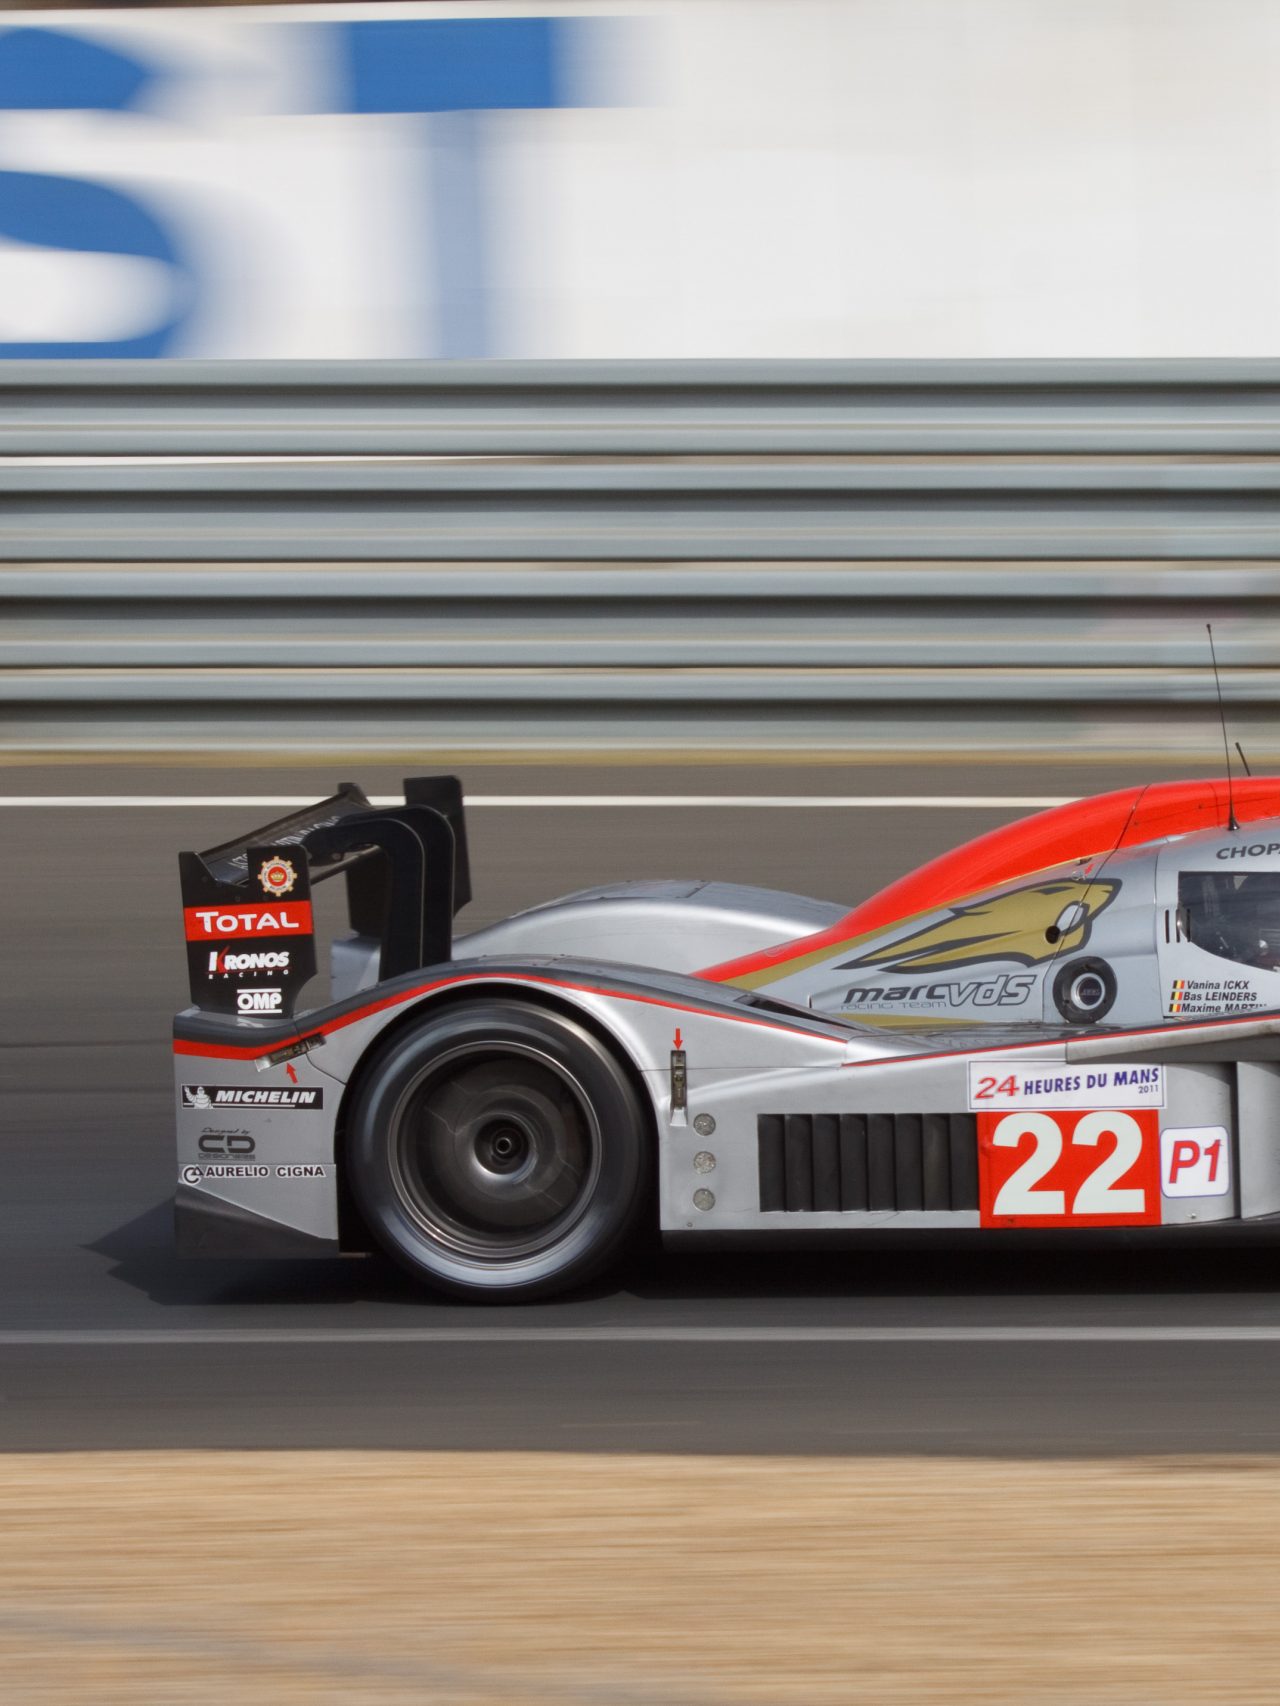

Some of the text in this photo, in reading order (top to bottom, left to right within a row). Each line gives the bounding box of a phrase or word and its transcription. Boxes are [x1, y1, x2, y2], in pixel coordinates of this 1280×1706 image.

[195, 911, 300, 933] TOTAL
[208, 947, 290, 973] KRONOS
[208, 969, 290, 980] RACING
[1187, 980, 1250, 990] Vanina ICKX
[236, 991, 283, 1011] OMP
[1183, 991, 1257, 1002] Bas LEINDERS
[1181, 1003, 1221, 1013] Maxime
[973, 1067, 1159, 1100] 24 HEURES DU MANS
[1138, 1084, 1159, 1094] 2011
[215, 1090, 317, 1104] MICHELIN
[992, 1110, 1146, 1216] 22
[1168, 1138, 1223, 1185] P1
[206, 1166, 325, 1178] AURELIO CIGNA
